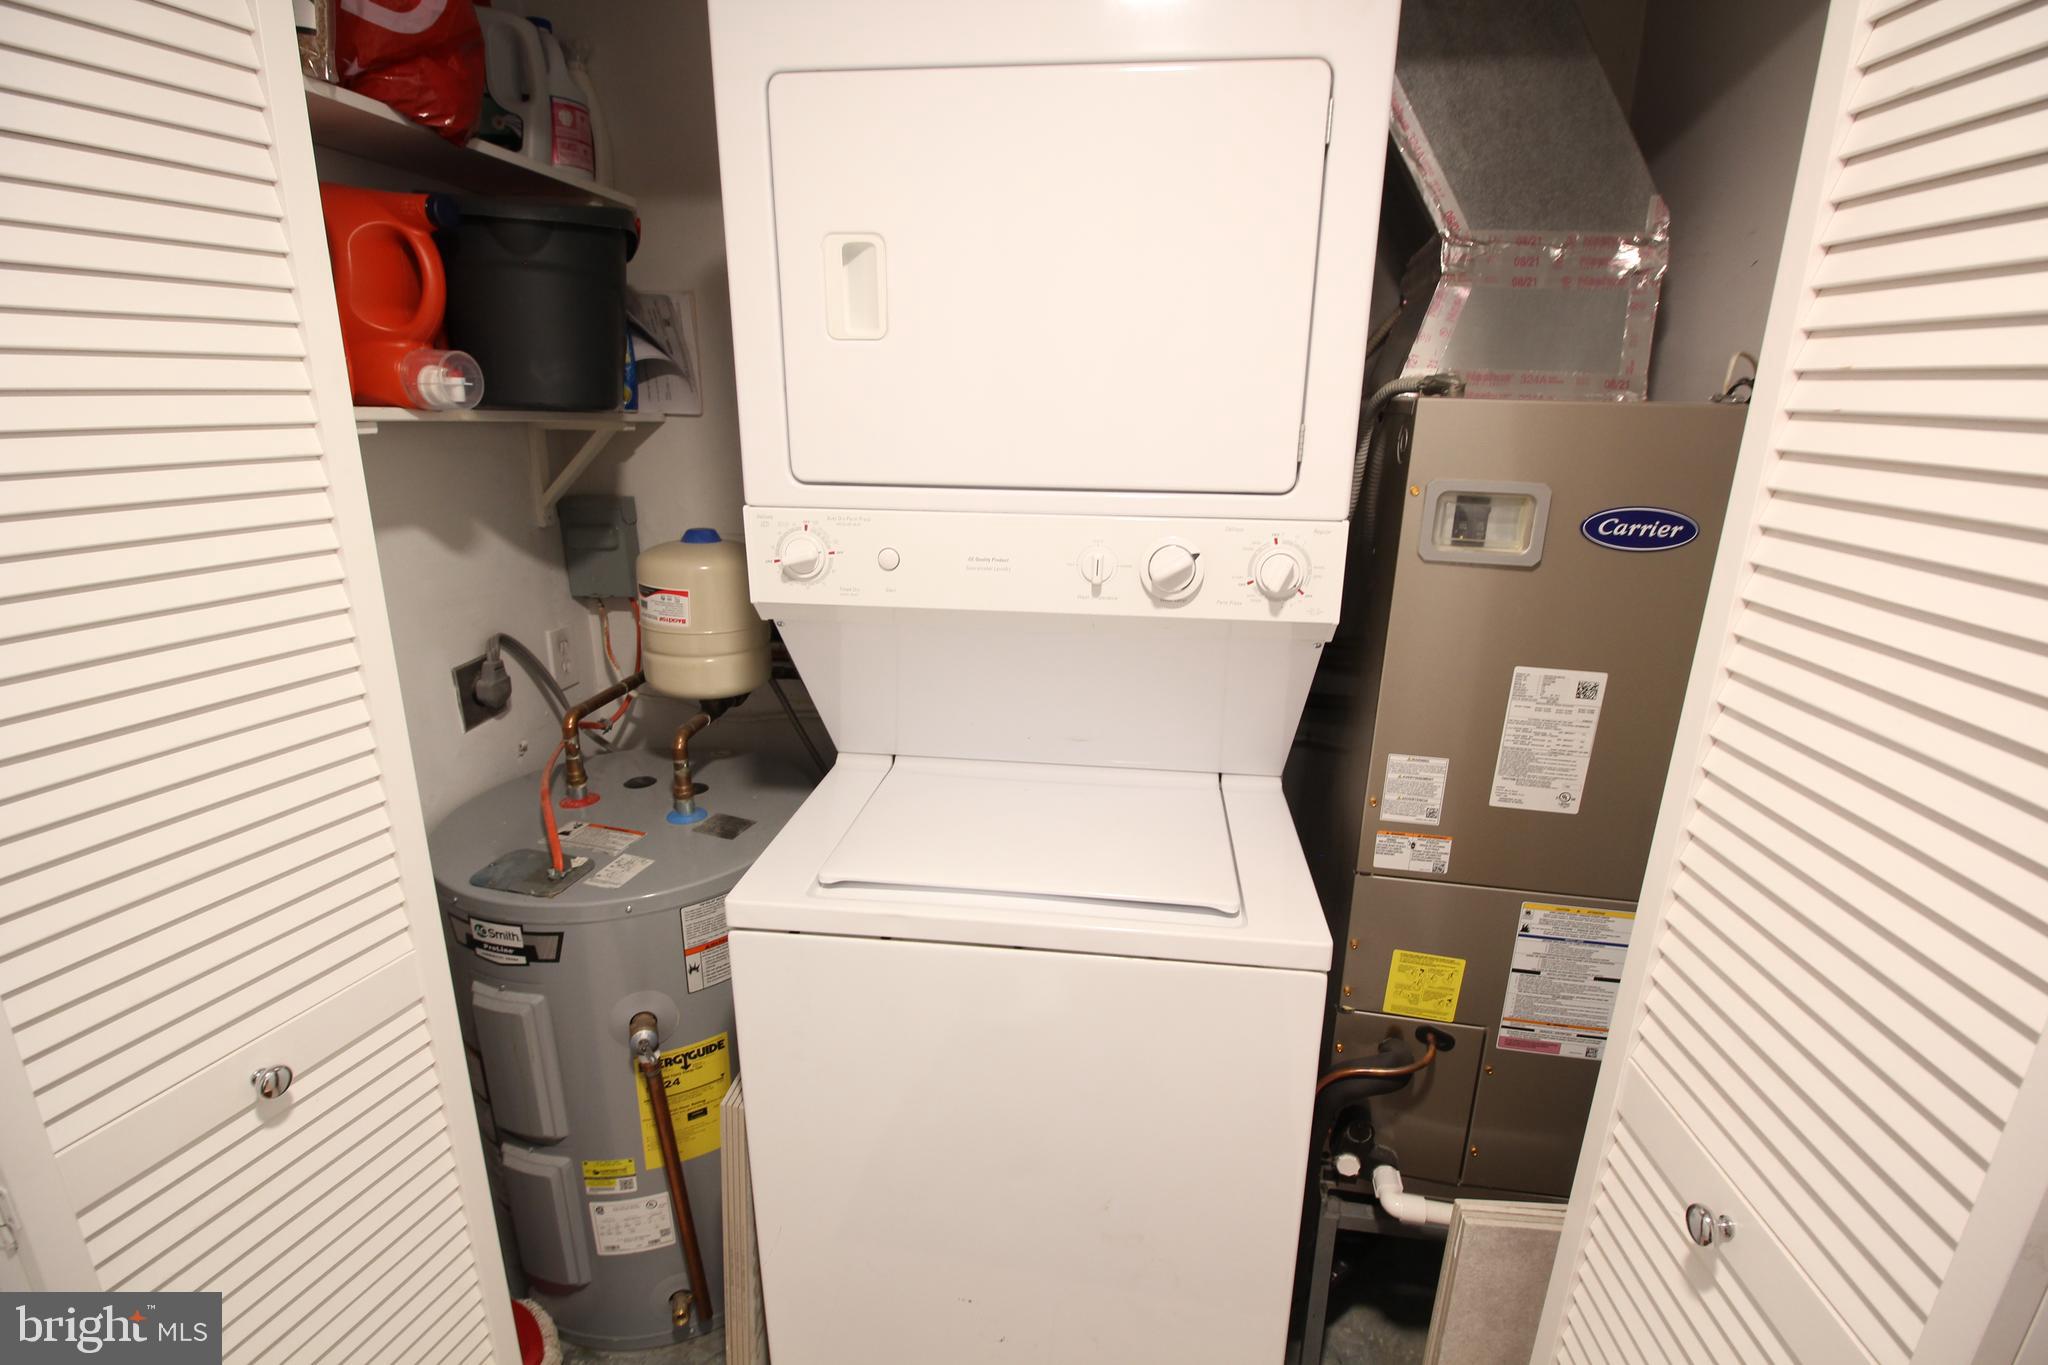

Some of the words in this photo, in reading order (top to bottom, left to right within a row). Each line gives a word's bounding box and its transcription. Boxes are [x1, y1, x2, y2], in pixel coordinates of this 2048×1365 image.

[1597, 518, 1684, 538] Carrier
[488, 928, 519, 942] Smith
[657, 1038, 726, 1070] ERGYGUIDE
[663, 1077, 681, 1089] 24
